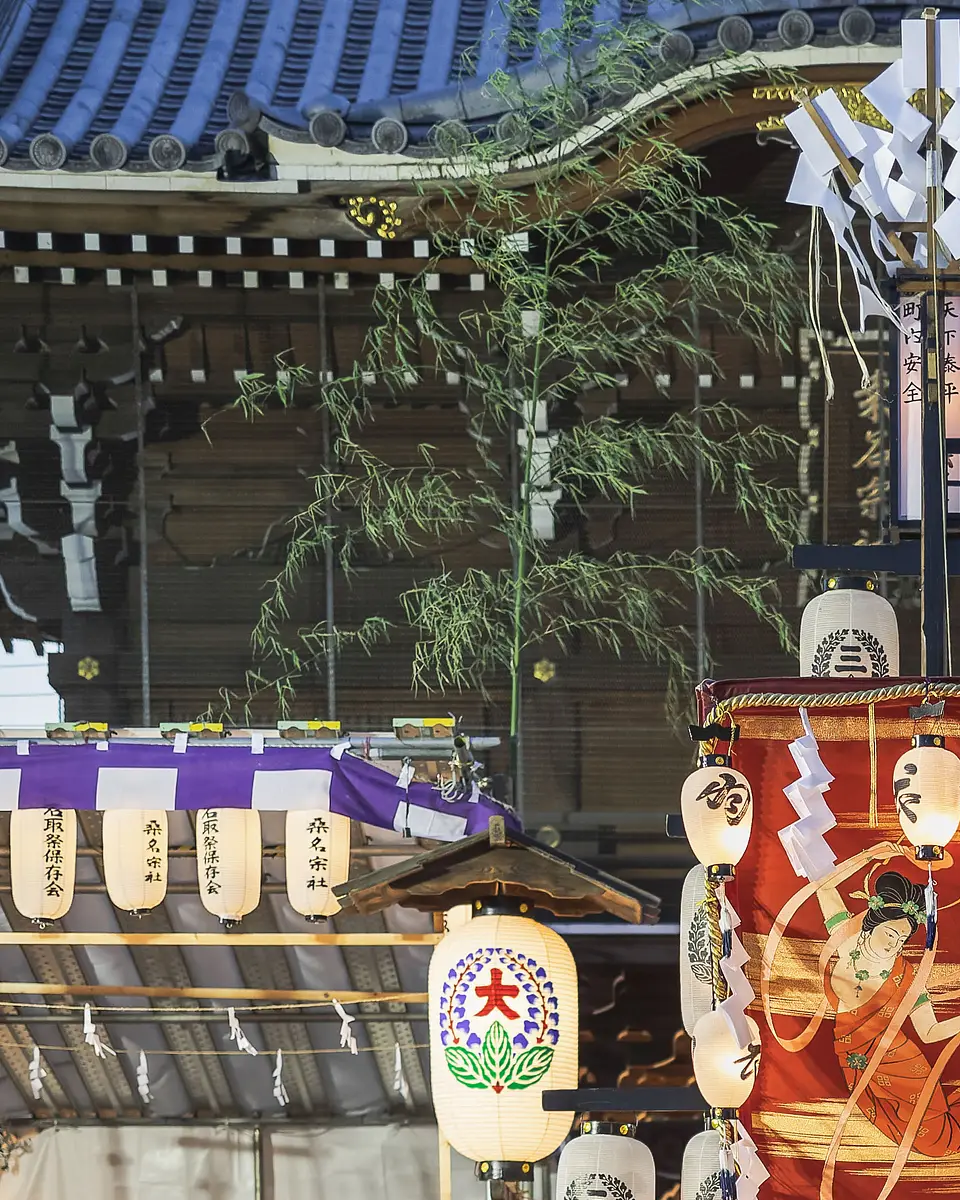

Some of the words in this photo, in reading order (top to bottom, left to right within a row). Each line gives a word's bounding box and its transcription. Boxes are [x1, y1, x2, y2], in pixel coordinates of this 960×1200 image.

[143, 820, 163, 883] 桑名宗社
[307, 817, 329, 891] 桑名宗社
[473, 967, 521, 1020] 大
